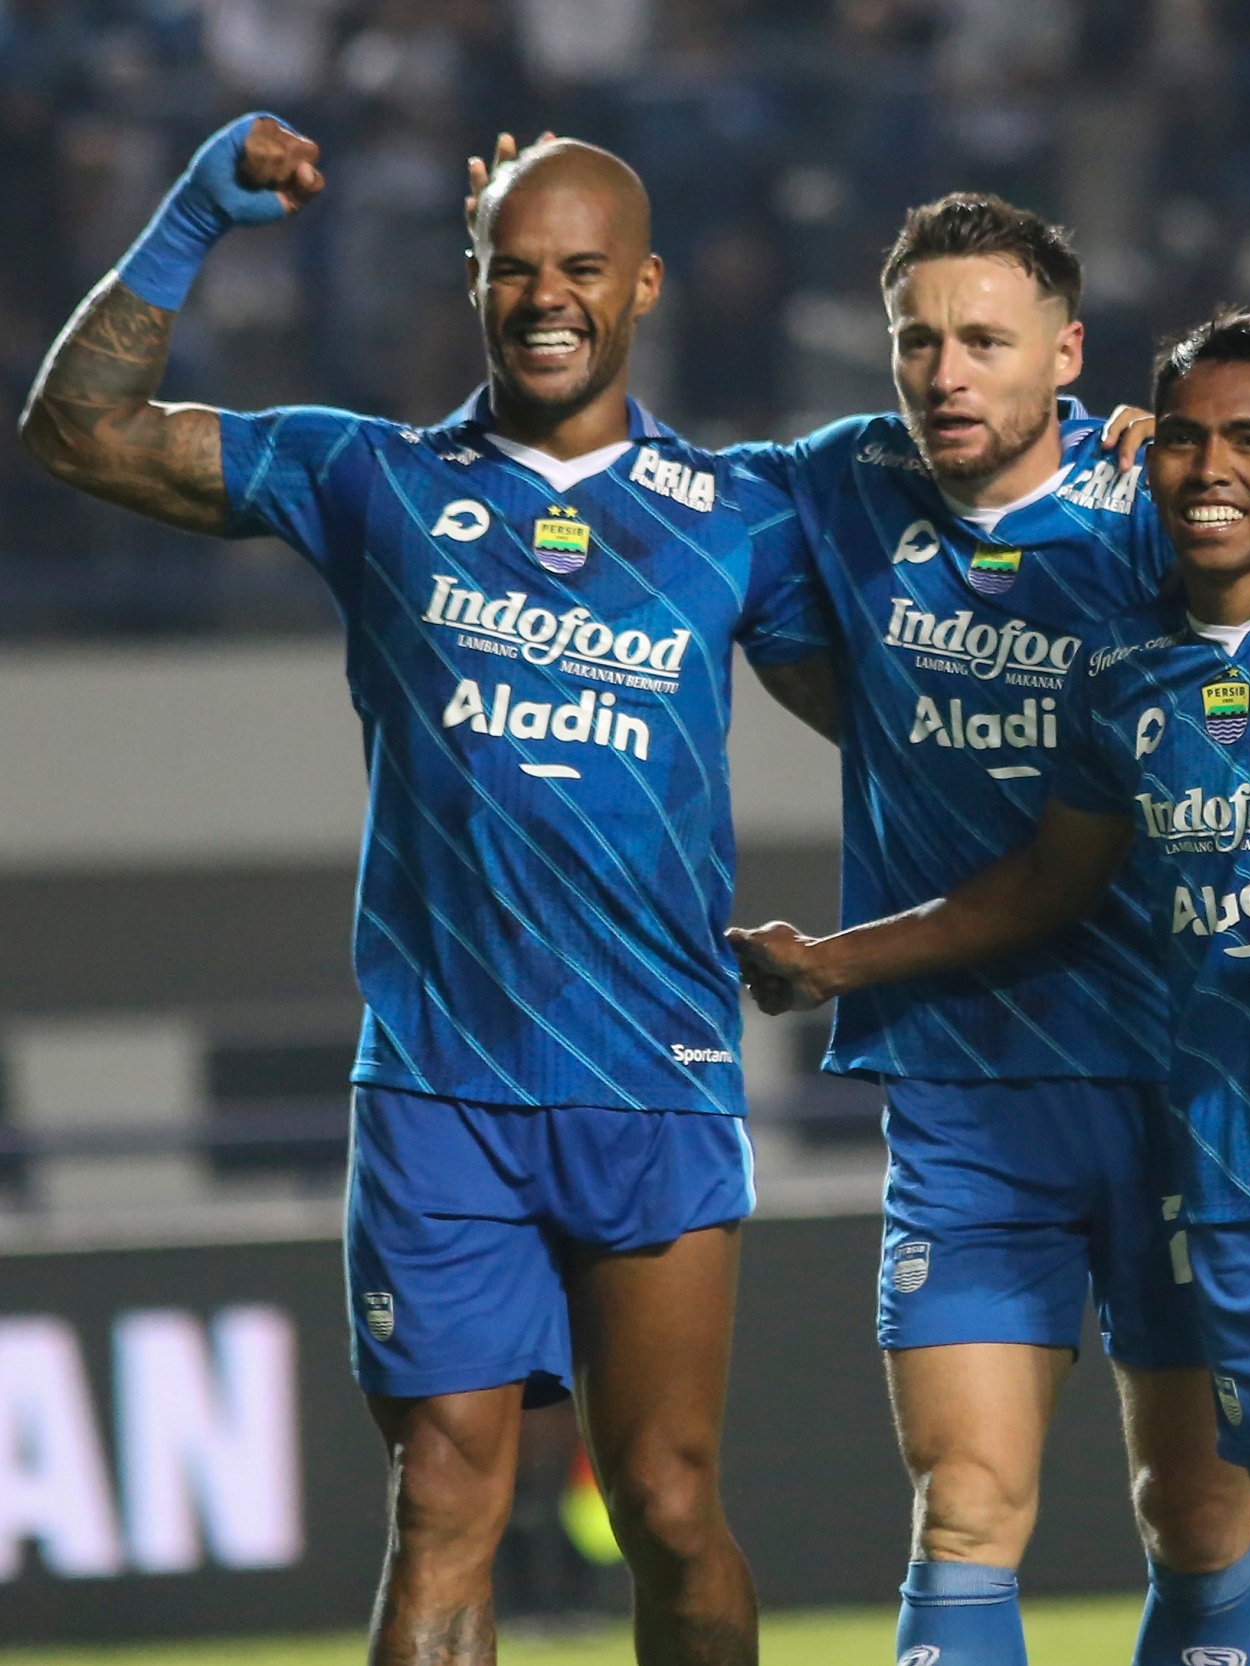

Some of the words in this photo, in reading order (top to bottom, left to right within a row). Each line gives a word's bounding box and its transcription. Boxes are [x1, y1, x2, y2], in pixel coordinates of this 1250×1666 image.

[632, 447, 715, 503] PRIA
[542, 524, 584, 536] PERSIB
[421, 574, 691, 665] Indofood
[458, 634, 518, 659] LAMBANG
[559, 660, 626, 686] MAKANAN
[625, 675, 680, 695] BERMUTU
[1005, 673, 1064, 690] MAKANAN
[1207, 686, 1246, 698] PERSIB
[442, 678, 650, 761] Aladin
[908, 695, 1058, 750] Aladi
